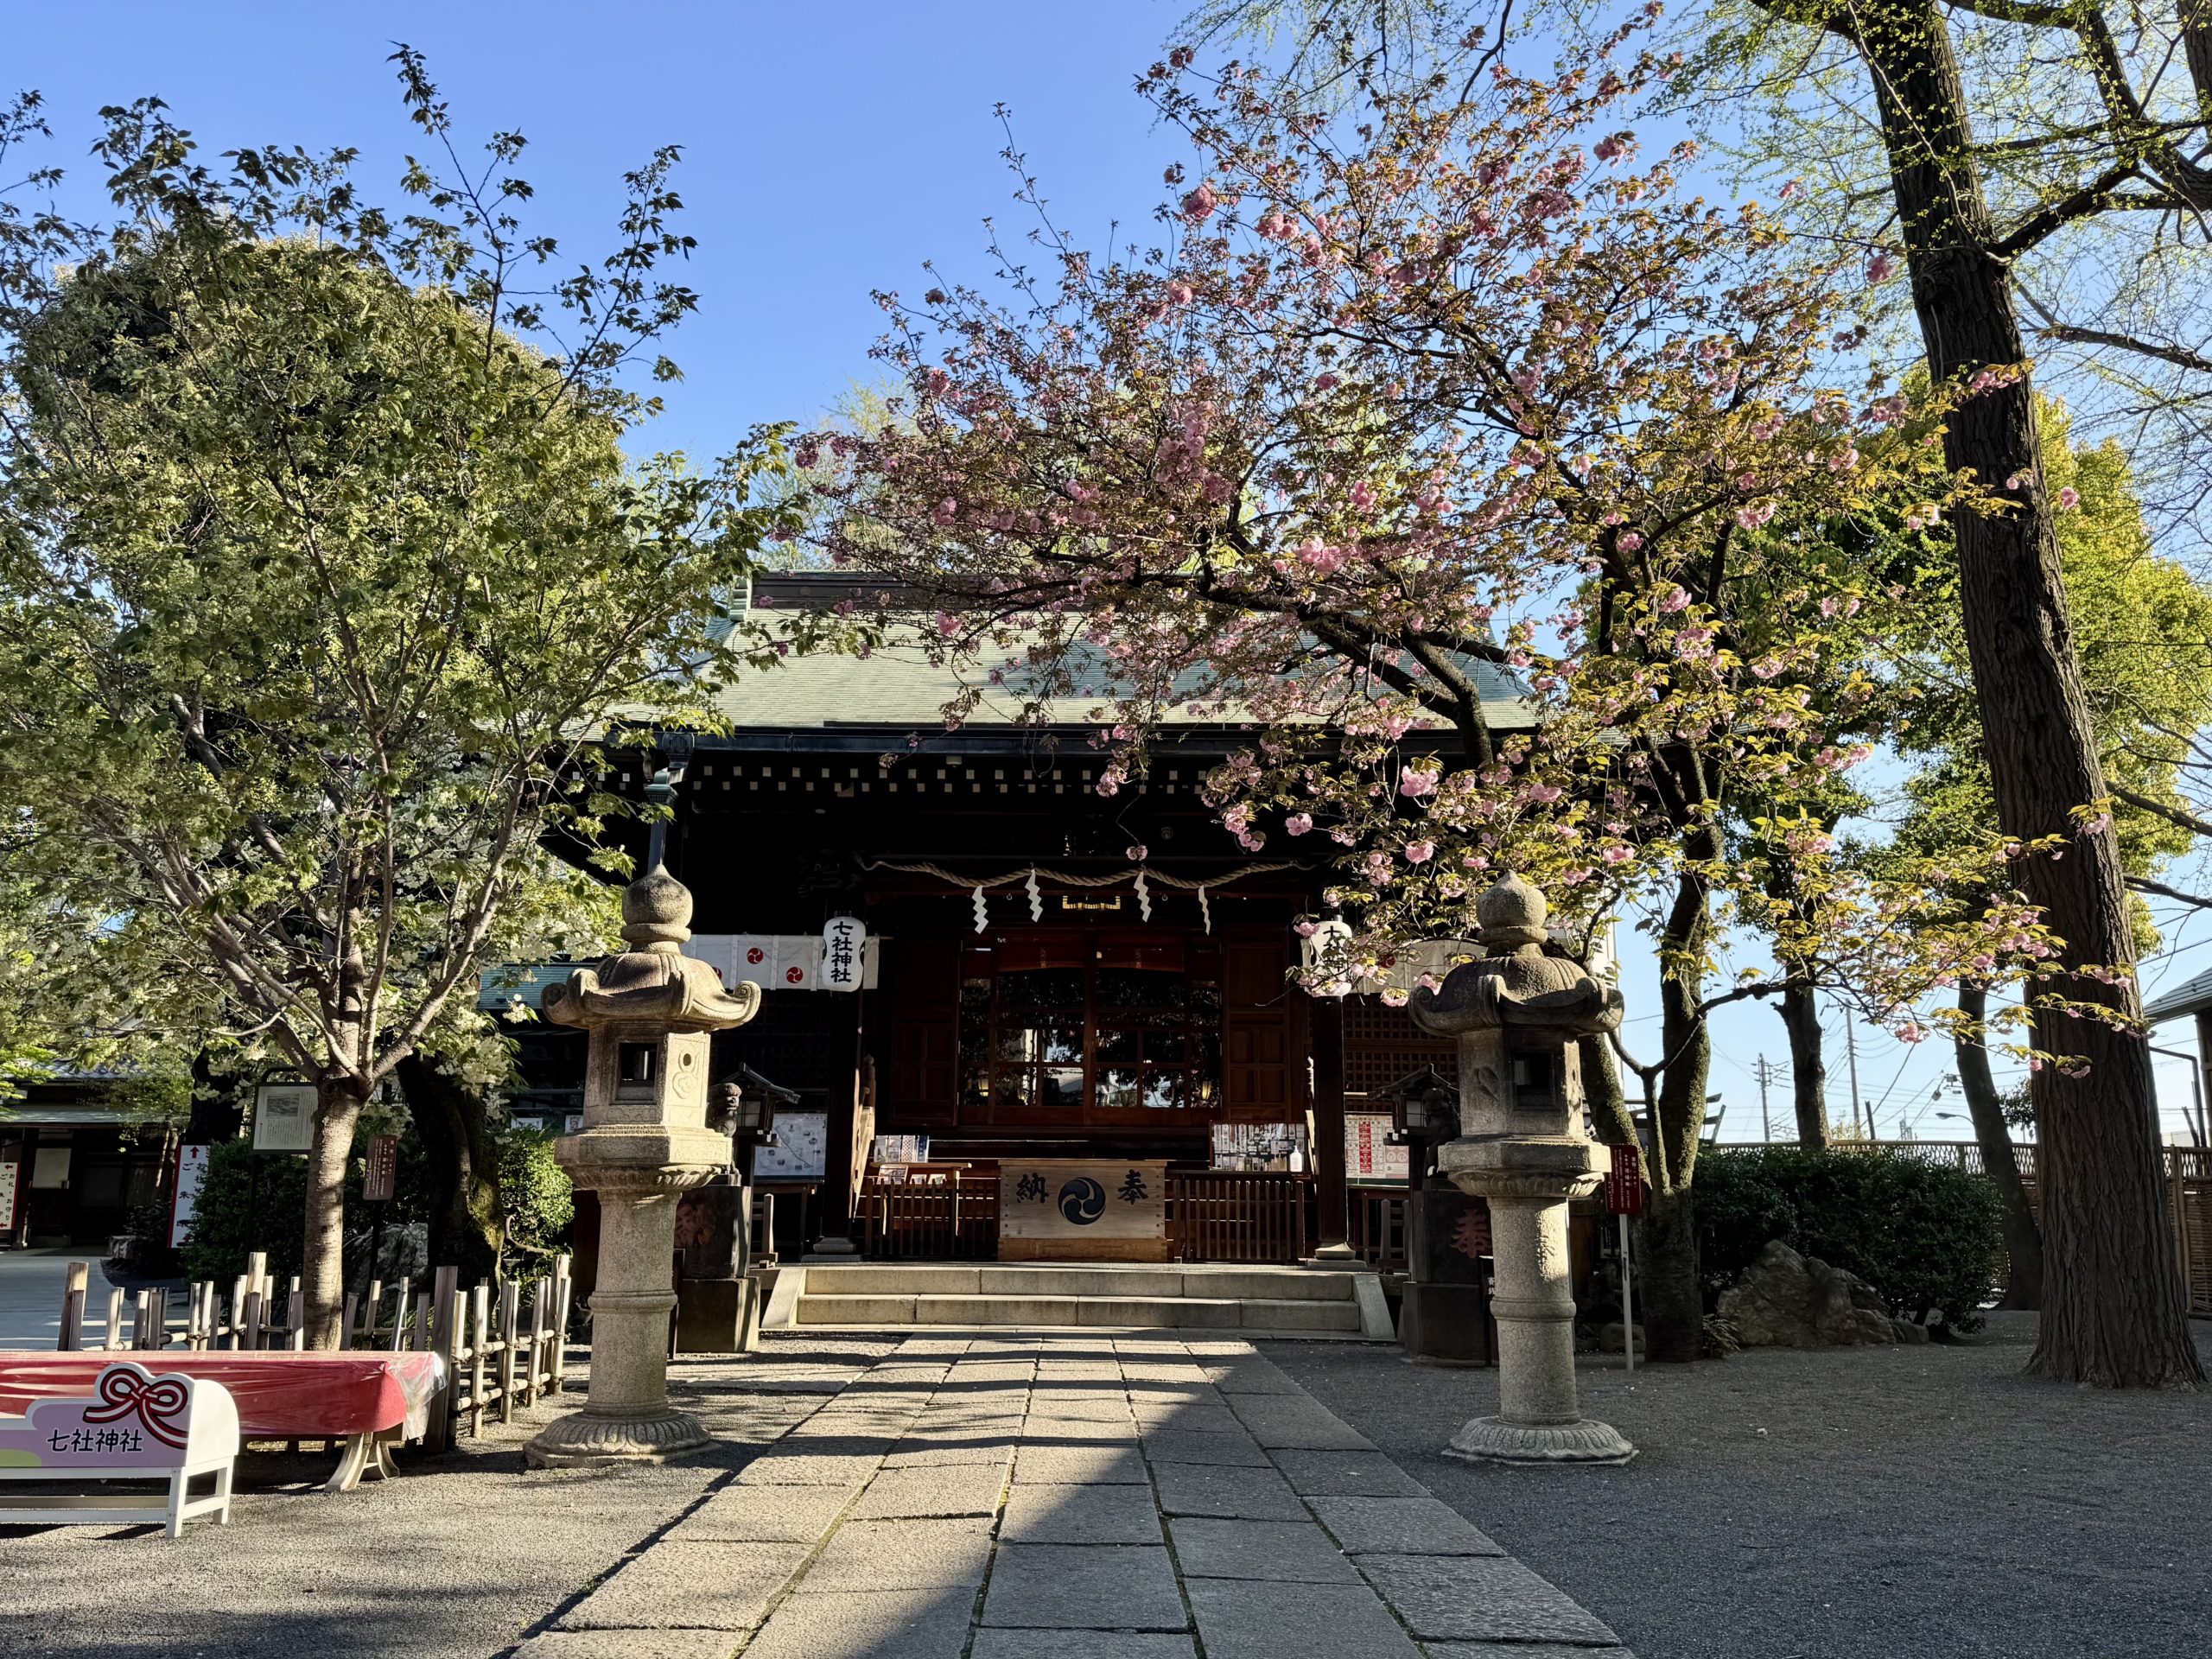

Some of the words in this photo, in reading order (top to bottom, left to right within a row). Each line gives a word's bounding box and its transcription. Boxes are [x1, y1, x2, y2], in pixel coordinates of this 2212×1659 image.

[831, 920, 854, 983] 七社神社
[1016, 1173, 1050, 1204] 納
[1117, 1169, 1149, 1205] 奉
[47, 1428, 143, 1453] 七社神社
